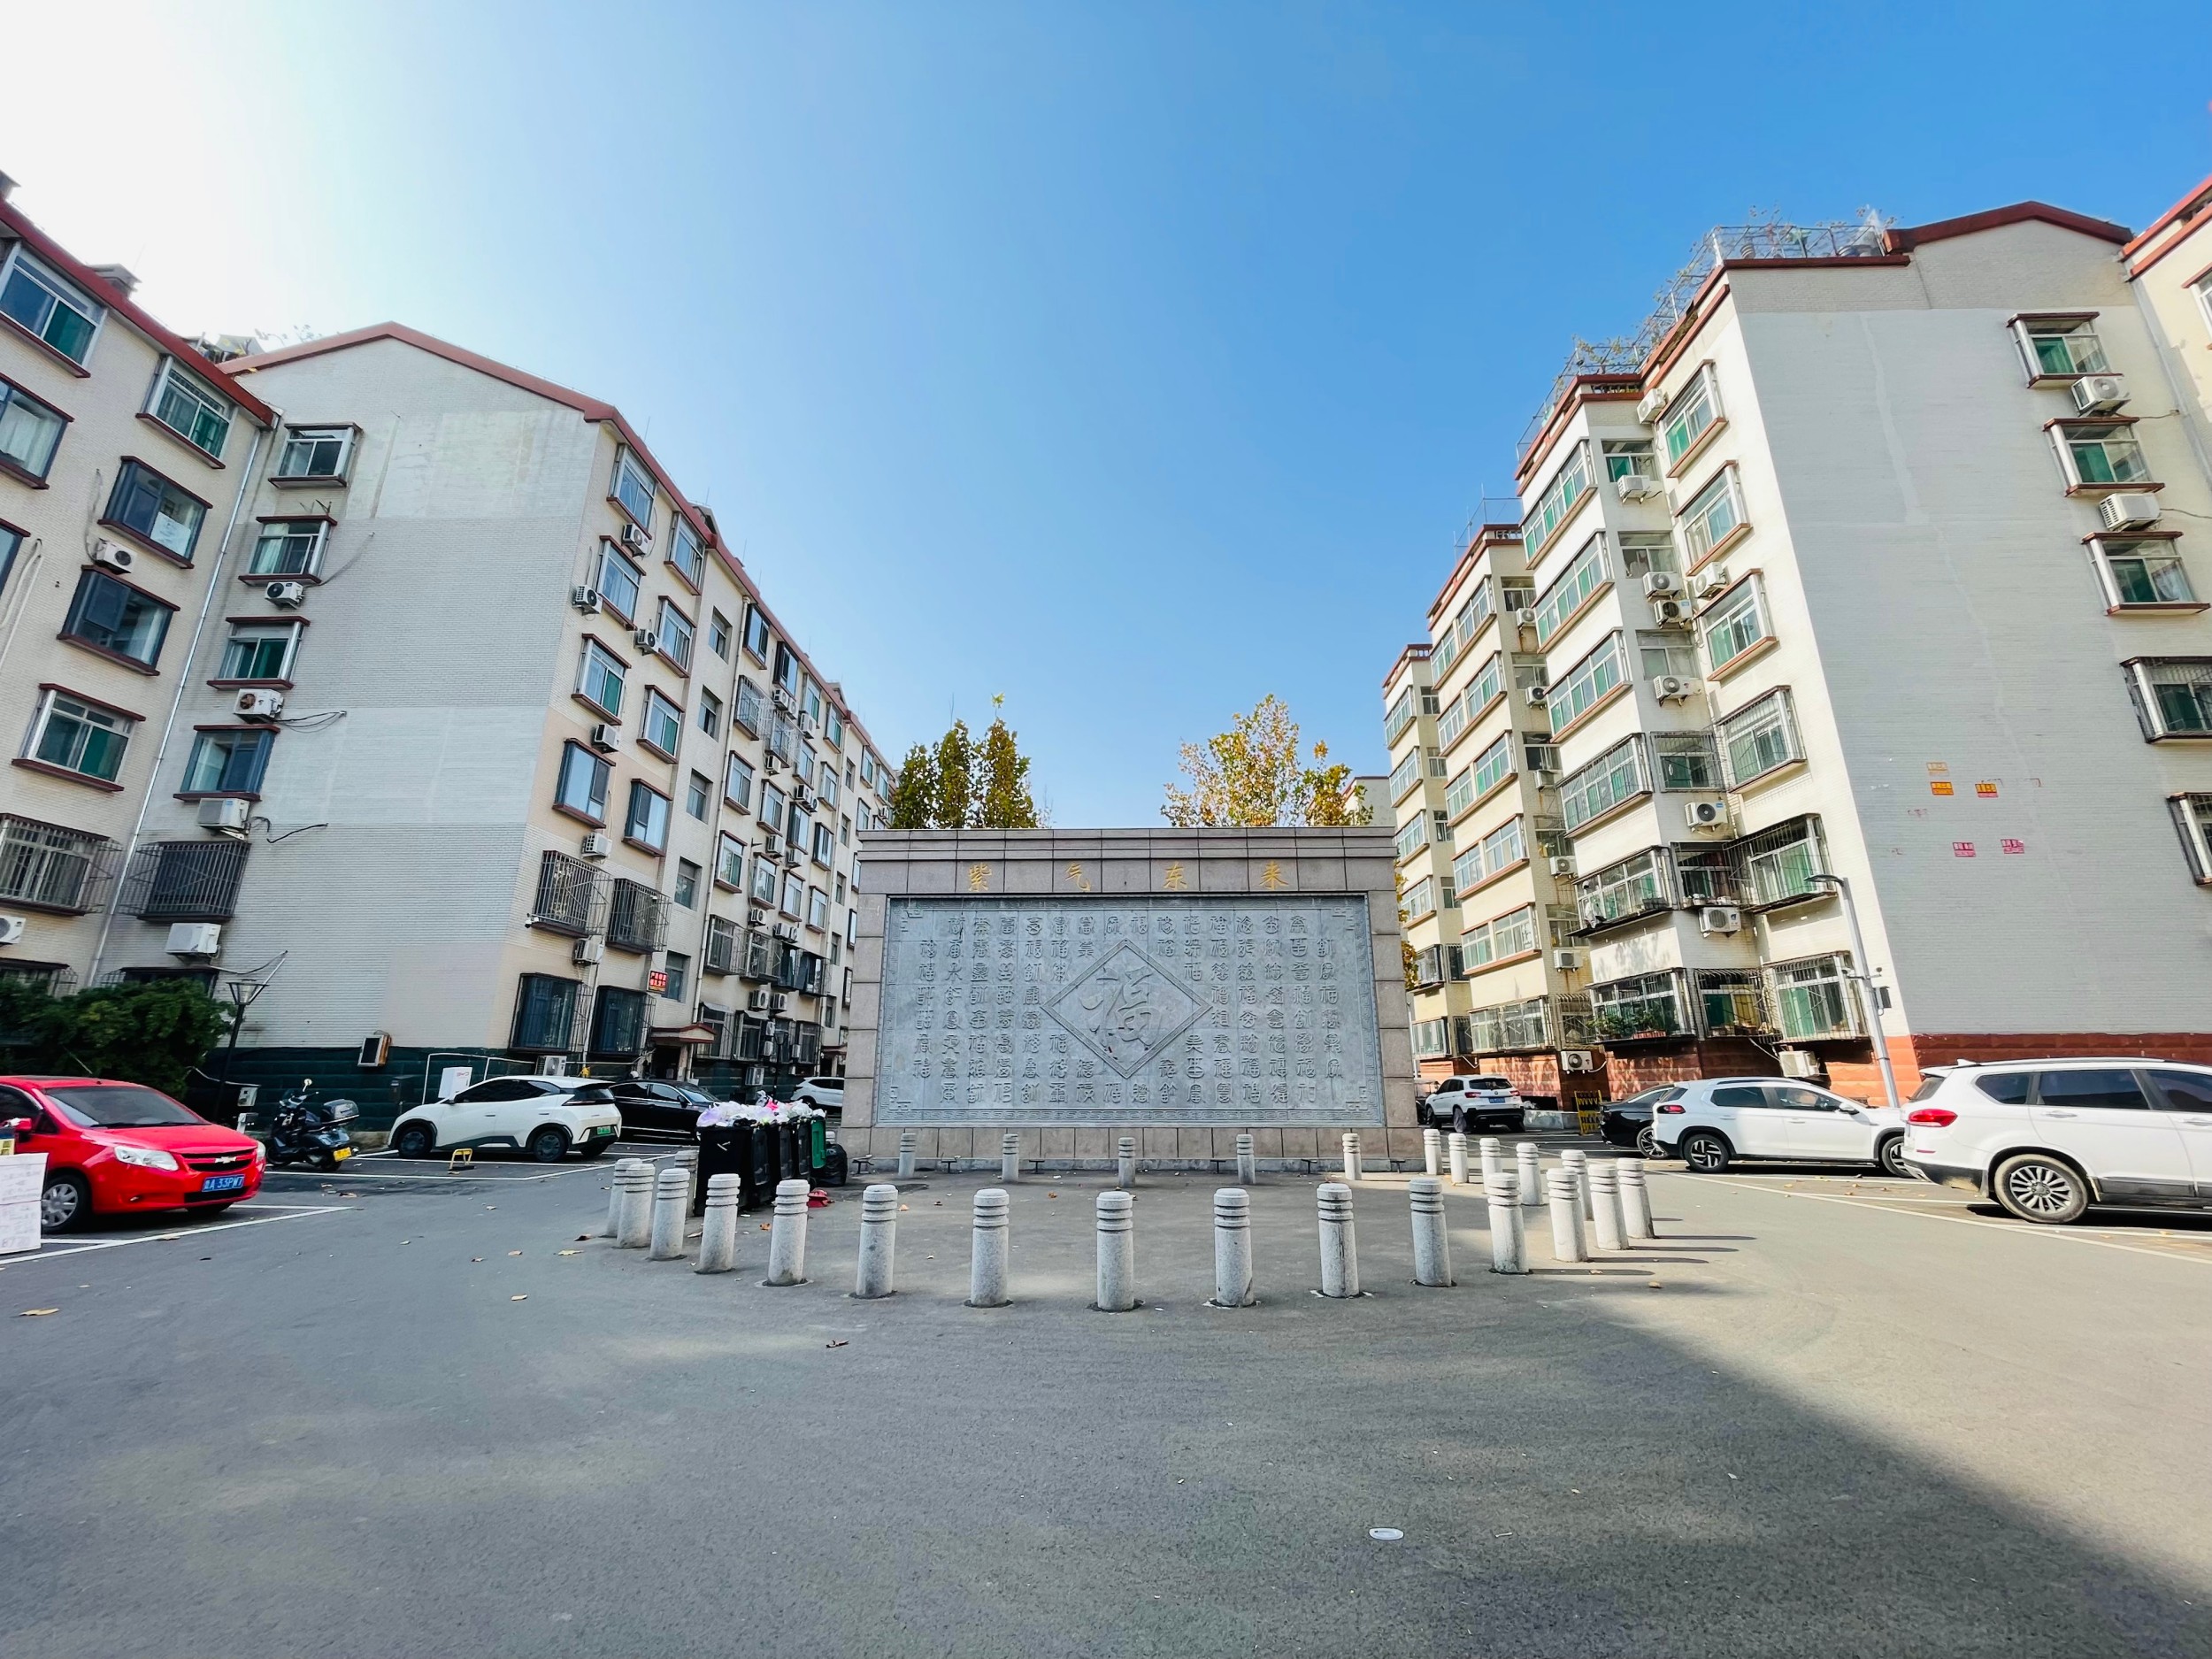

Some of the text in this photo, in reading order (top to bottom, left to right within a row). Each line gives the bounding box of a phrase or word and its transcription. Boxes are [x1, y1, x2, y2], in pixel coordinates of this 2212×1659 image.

[968, 860, 1289, 892] 紫气东来
[1079, 965, 1162, 1048] 福
